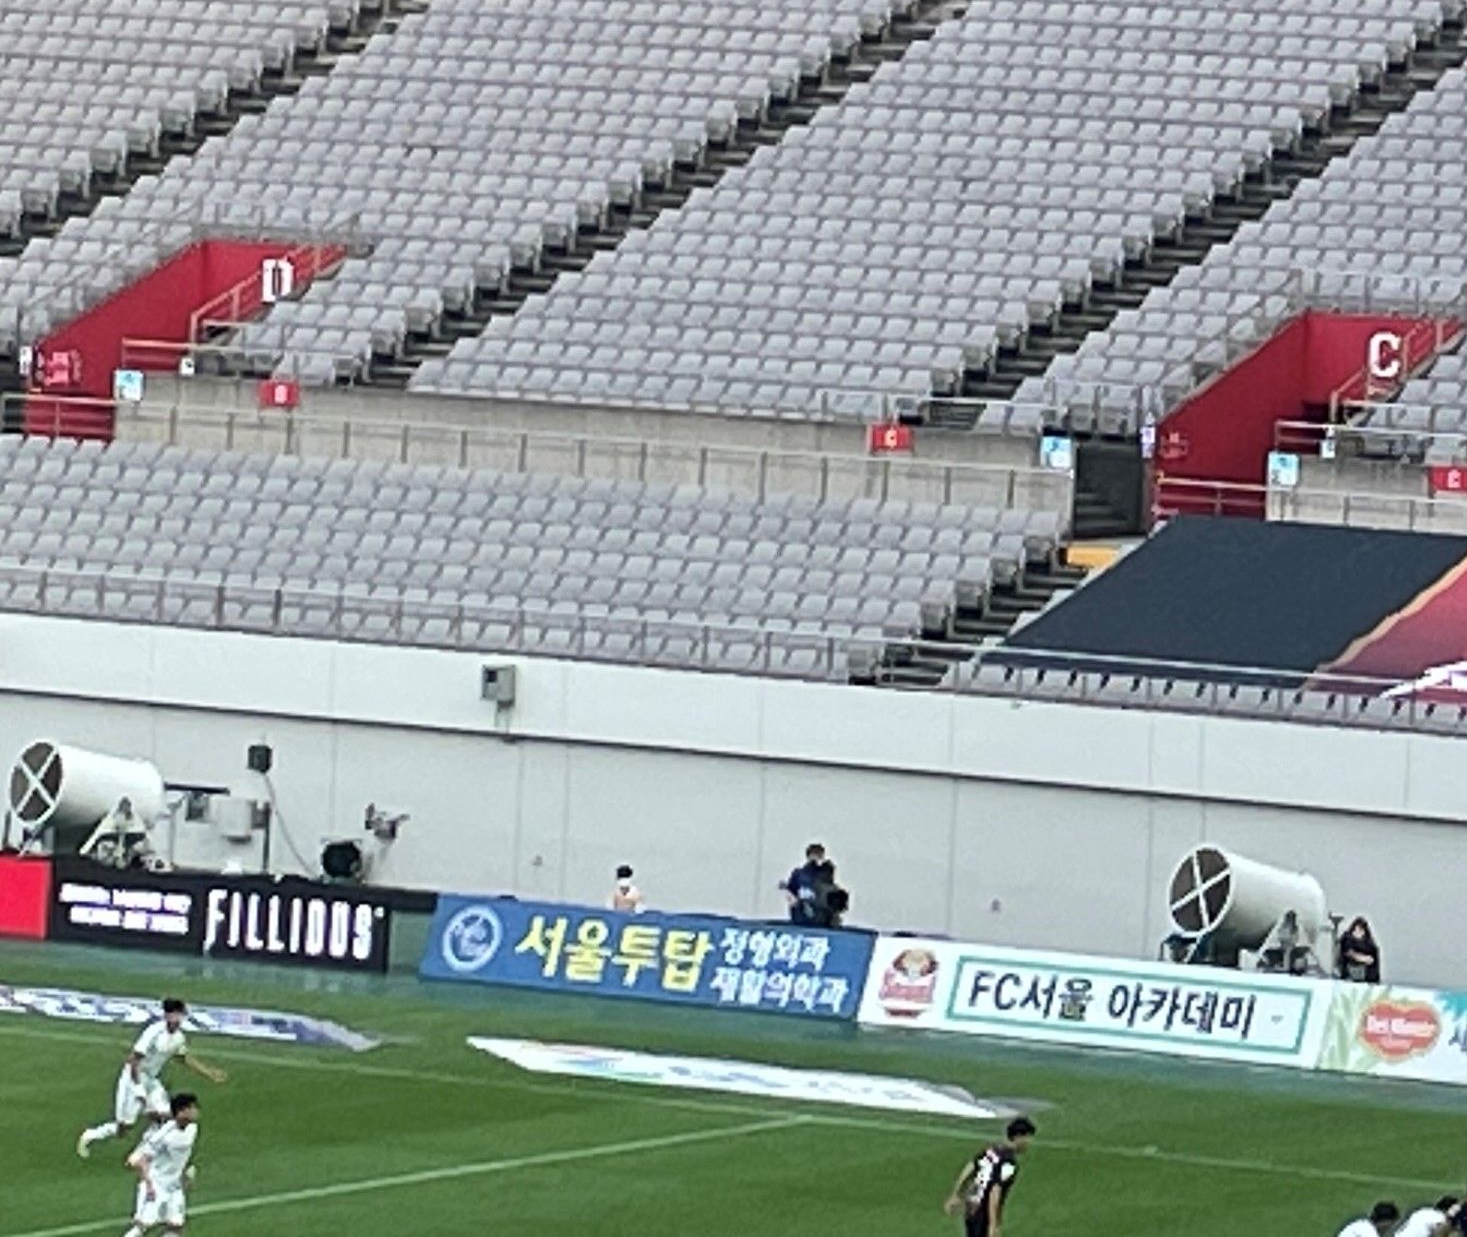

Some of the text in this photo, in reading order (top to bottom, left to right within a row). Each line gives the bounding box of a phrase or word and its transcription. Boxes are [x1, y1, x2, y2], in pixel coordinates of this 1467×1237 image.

[262, 259, 294, 302] D
[1369, 331, 1402, 378] C
[514, 914, 715, 993] 서울투탑
[719, 927, 831, 972] 정형외과
[709, 965, 850, 1014] 재활의학과
[968, 969, 1094, 1022] FC서울
[1108, 982, 1257, 1040] 아카데미
